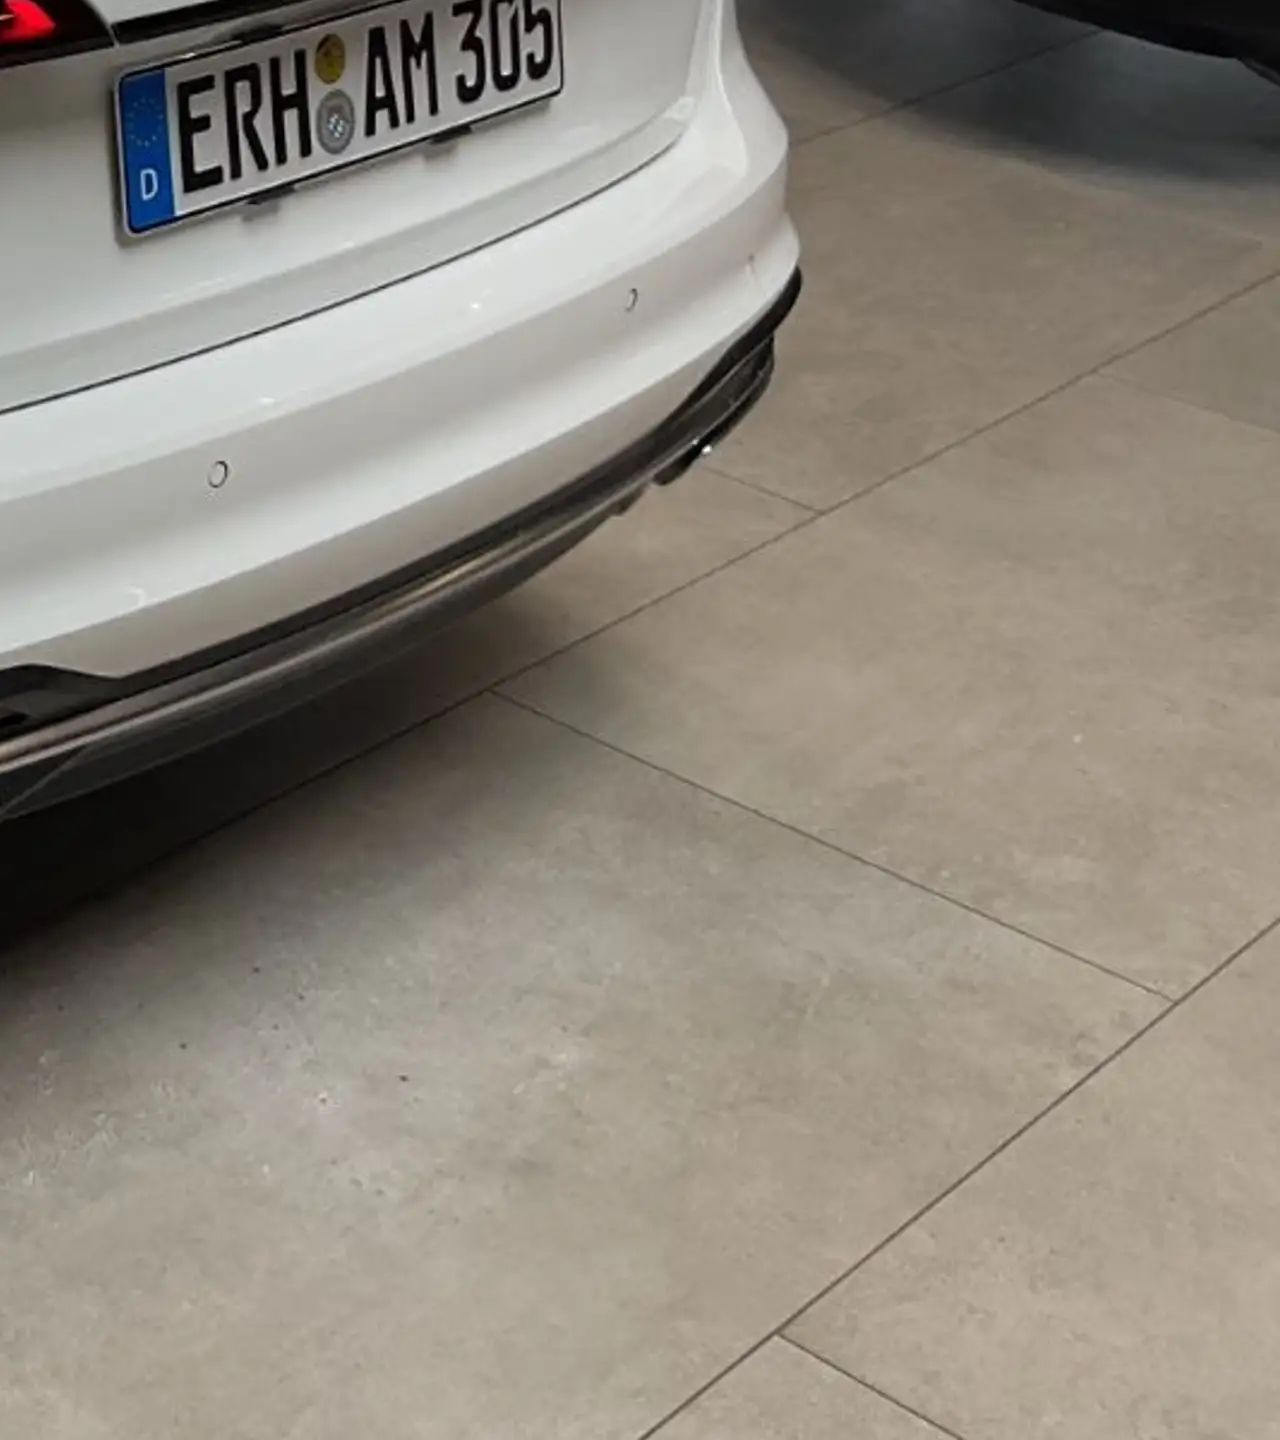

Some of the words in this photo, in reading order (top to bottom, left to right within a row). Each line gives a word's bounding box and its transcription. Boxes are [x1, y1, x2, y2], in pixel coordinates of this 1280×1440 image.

[176, 48, 313, 194] ERH
[364, 12, 439, 137] AM
[140, 167, 159, 201] D
